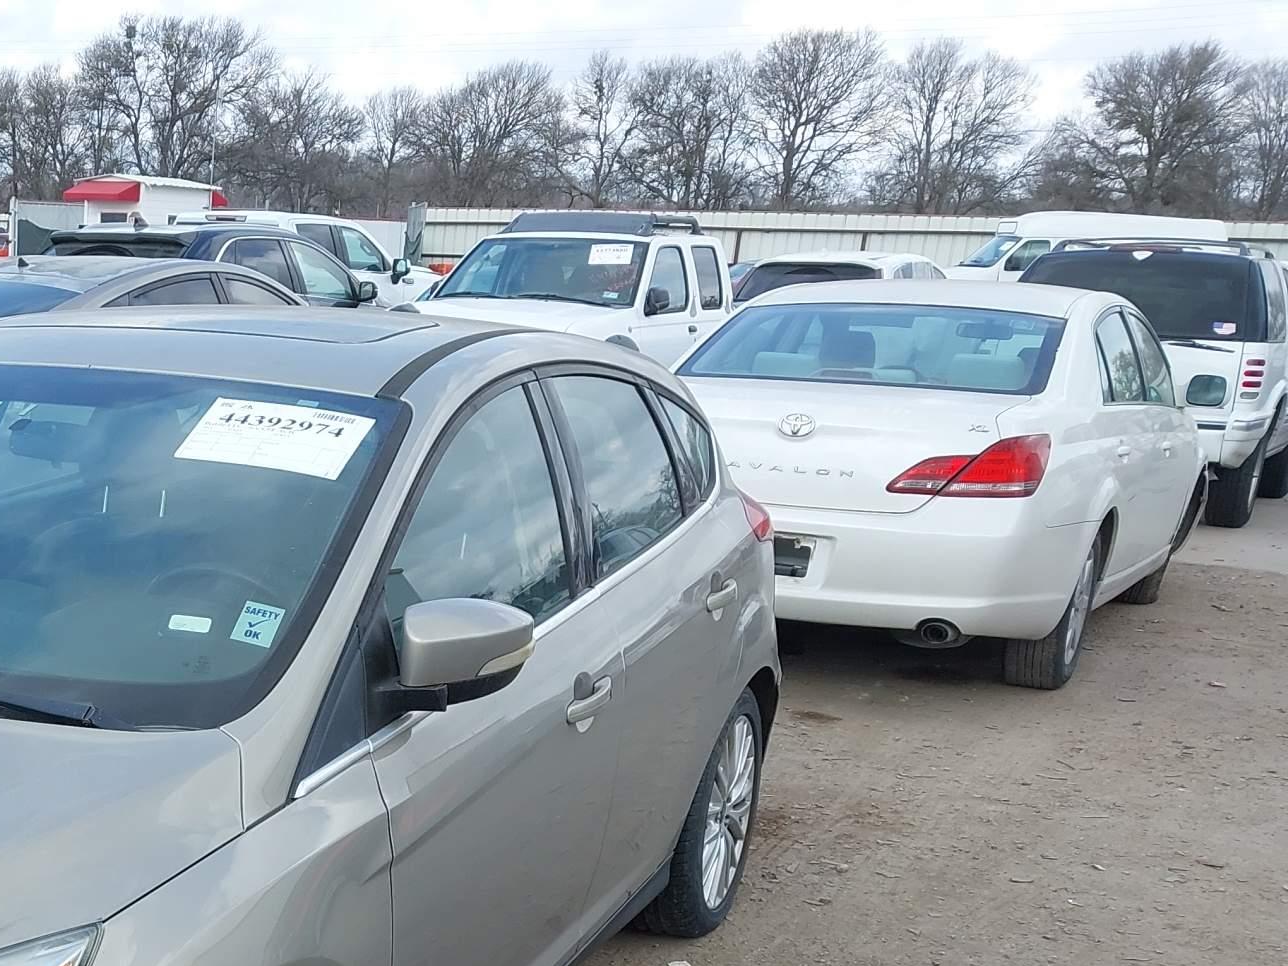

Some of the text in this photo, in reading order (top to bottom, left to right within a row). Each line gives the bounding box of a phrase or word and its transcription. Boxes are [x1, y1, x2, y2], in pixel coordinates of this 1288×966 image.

[219, 412, 345, 438] 44392974
[726, 461, 854, 478] AVALON
[244, 606, 280, 620] SAFETY
[244, 629, 262, 640] OK
